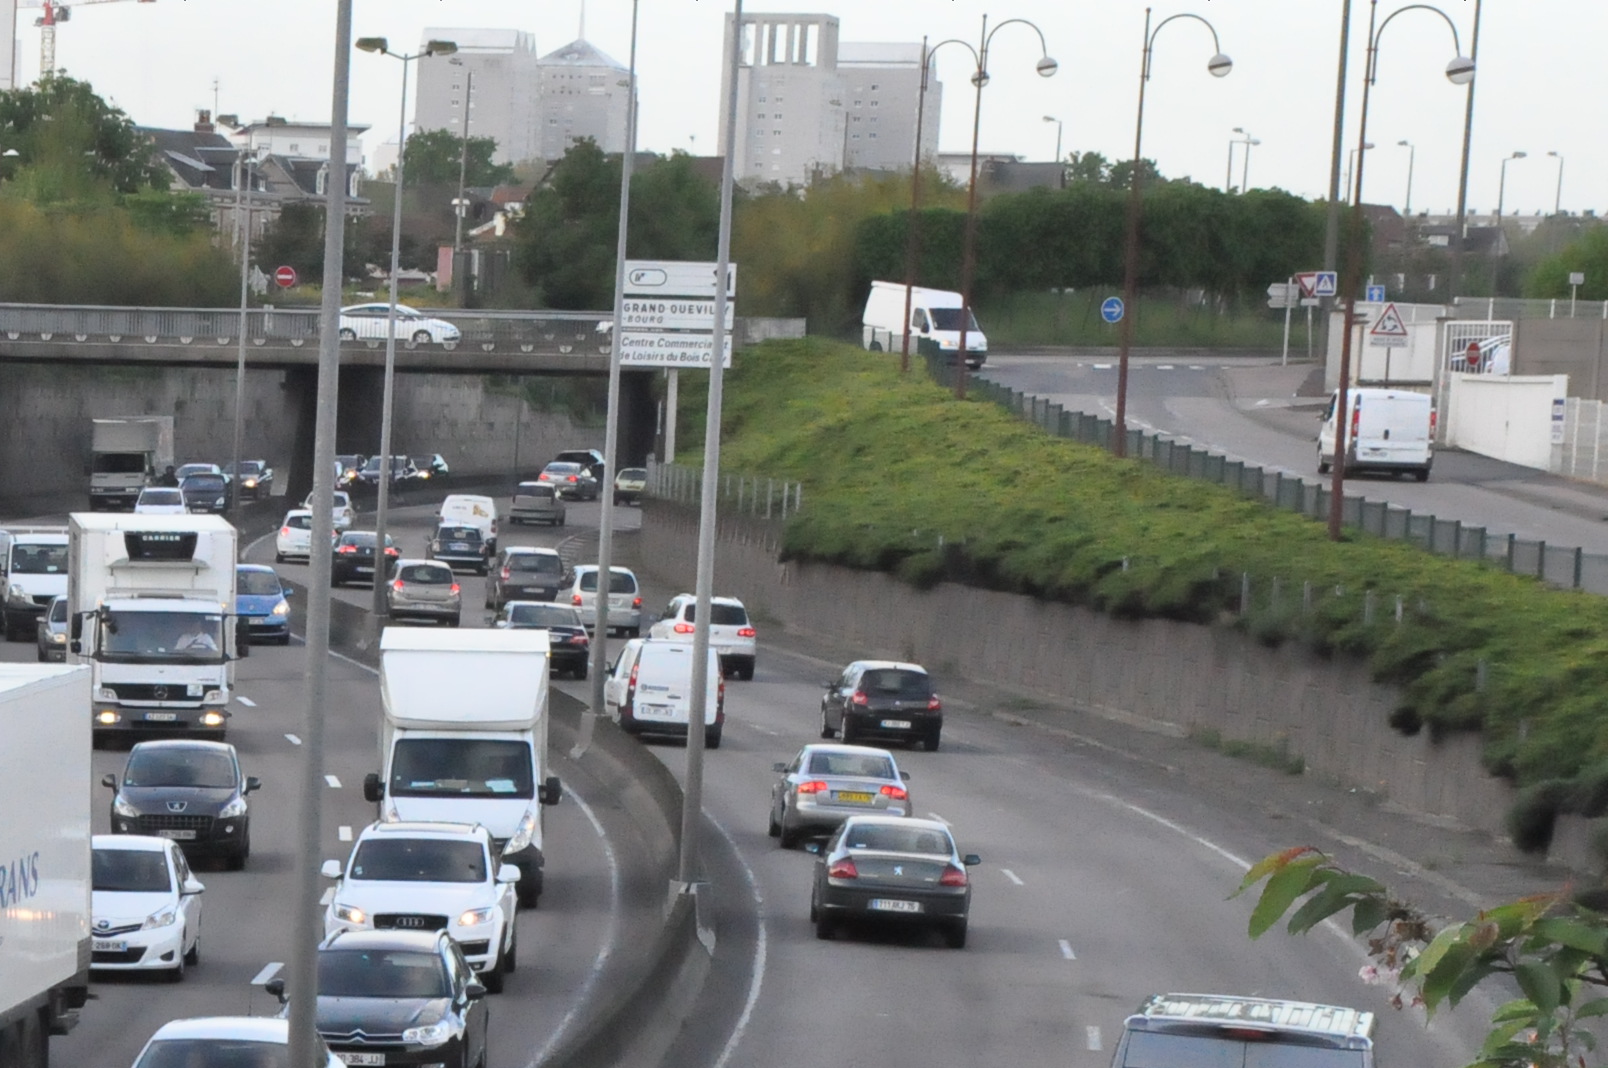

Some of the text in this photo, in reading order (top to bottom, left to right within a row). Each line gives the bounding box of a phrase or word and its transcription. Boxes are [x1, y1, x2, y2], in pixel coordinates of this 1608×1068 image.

[623, 303, 730, 315] GRAND QUEVILY
[622, 336, 655, 348] Centre
[657, 338, 713, 349] Commercia
[632, 351, 665, 361] Loisirs
[666, 352, 679, 361] du
[680, 352, 701, 362] Bois
